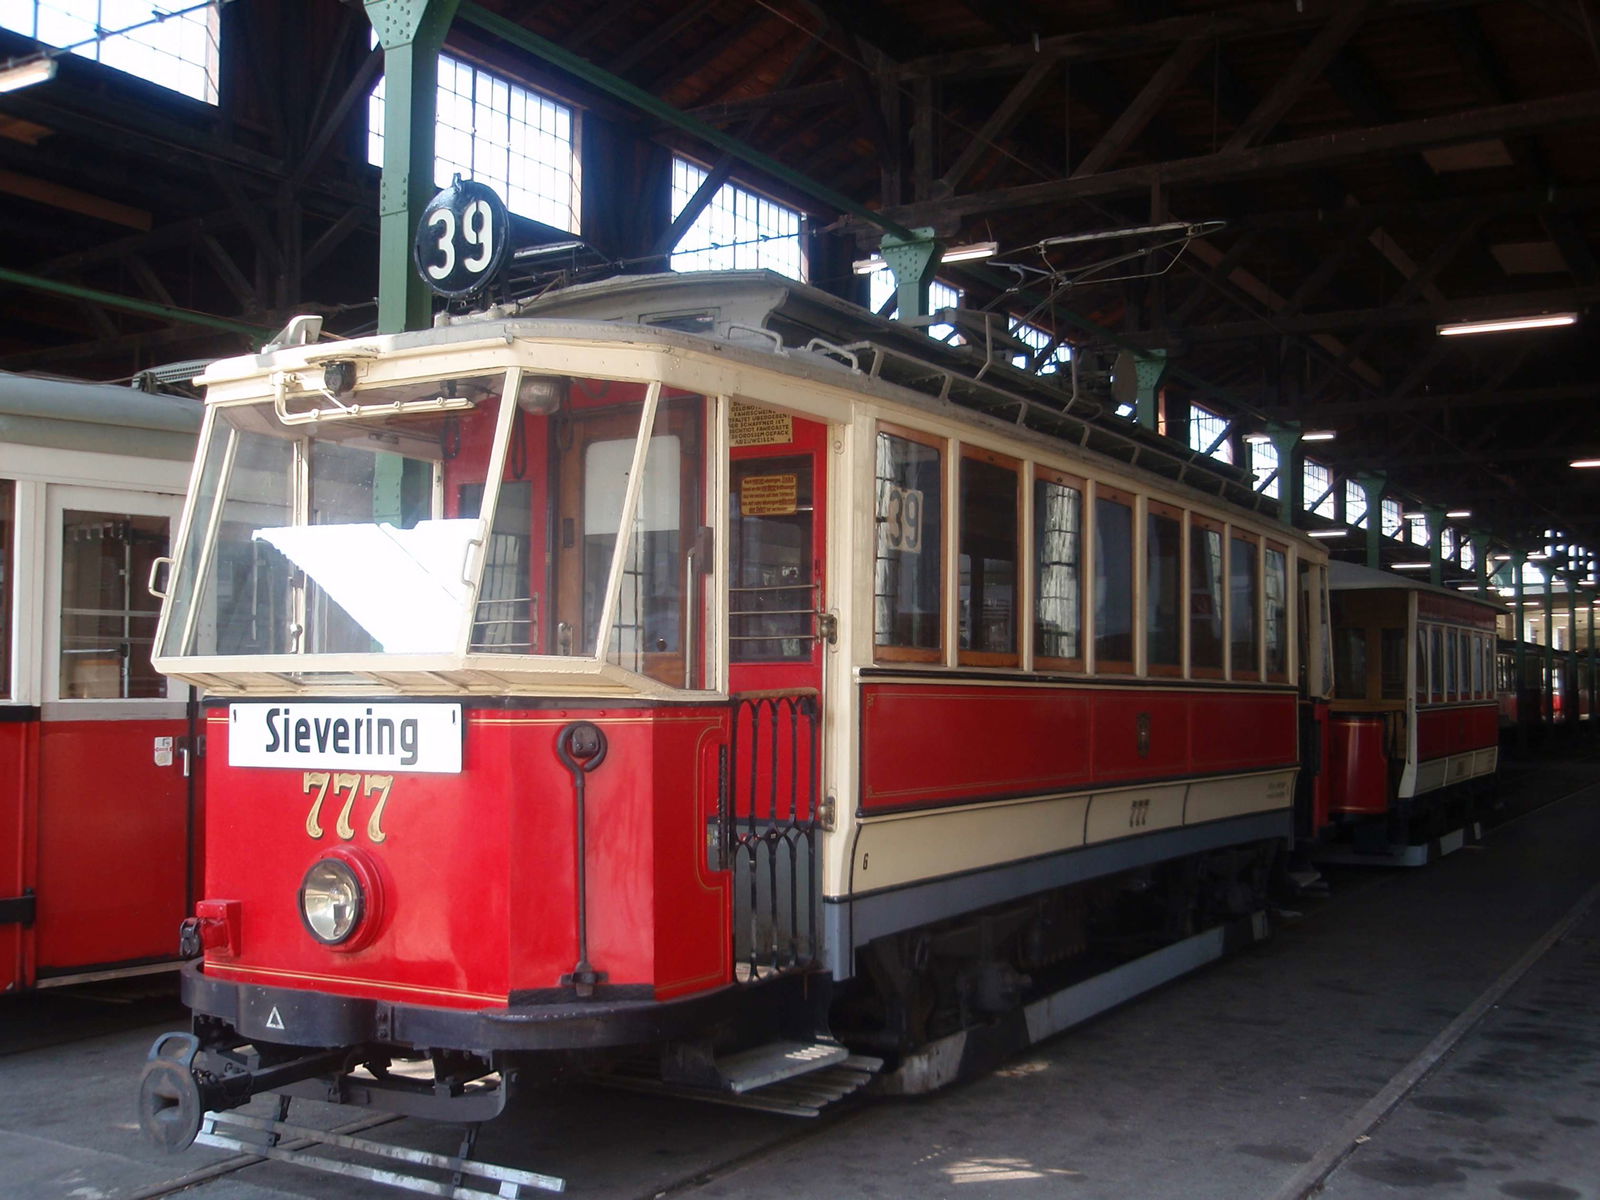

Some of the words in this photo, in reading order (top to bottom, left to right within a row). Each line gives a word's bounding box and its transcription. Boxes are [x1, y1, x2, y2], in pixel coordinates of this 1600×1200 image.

[428, 200, 493, 280] 39
[889, 489, 920, 549] 39
[266, 707, 419, 766] Sievering
[303, 771, 394, 843] 777
[1129, 799, 1150, 828] 777
